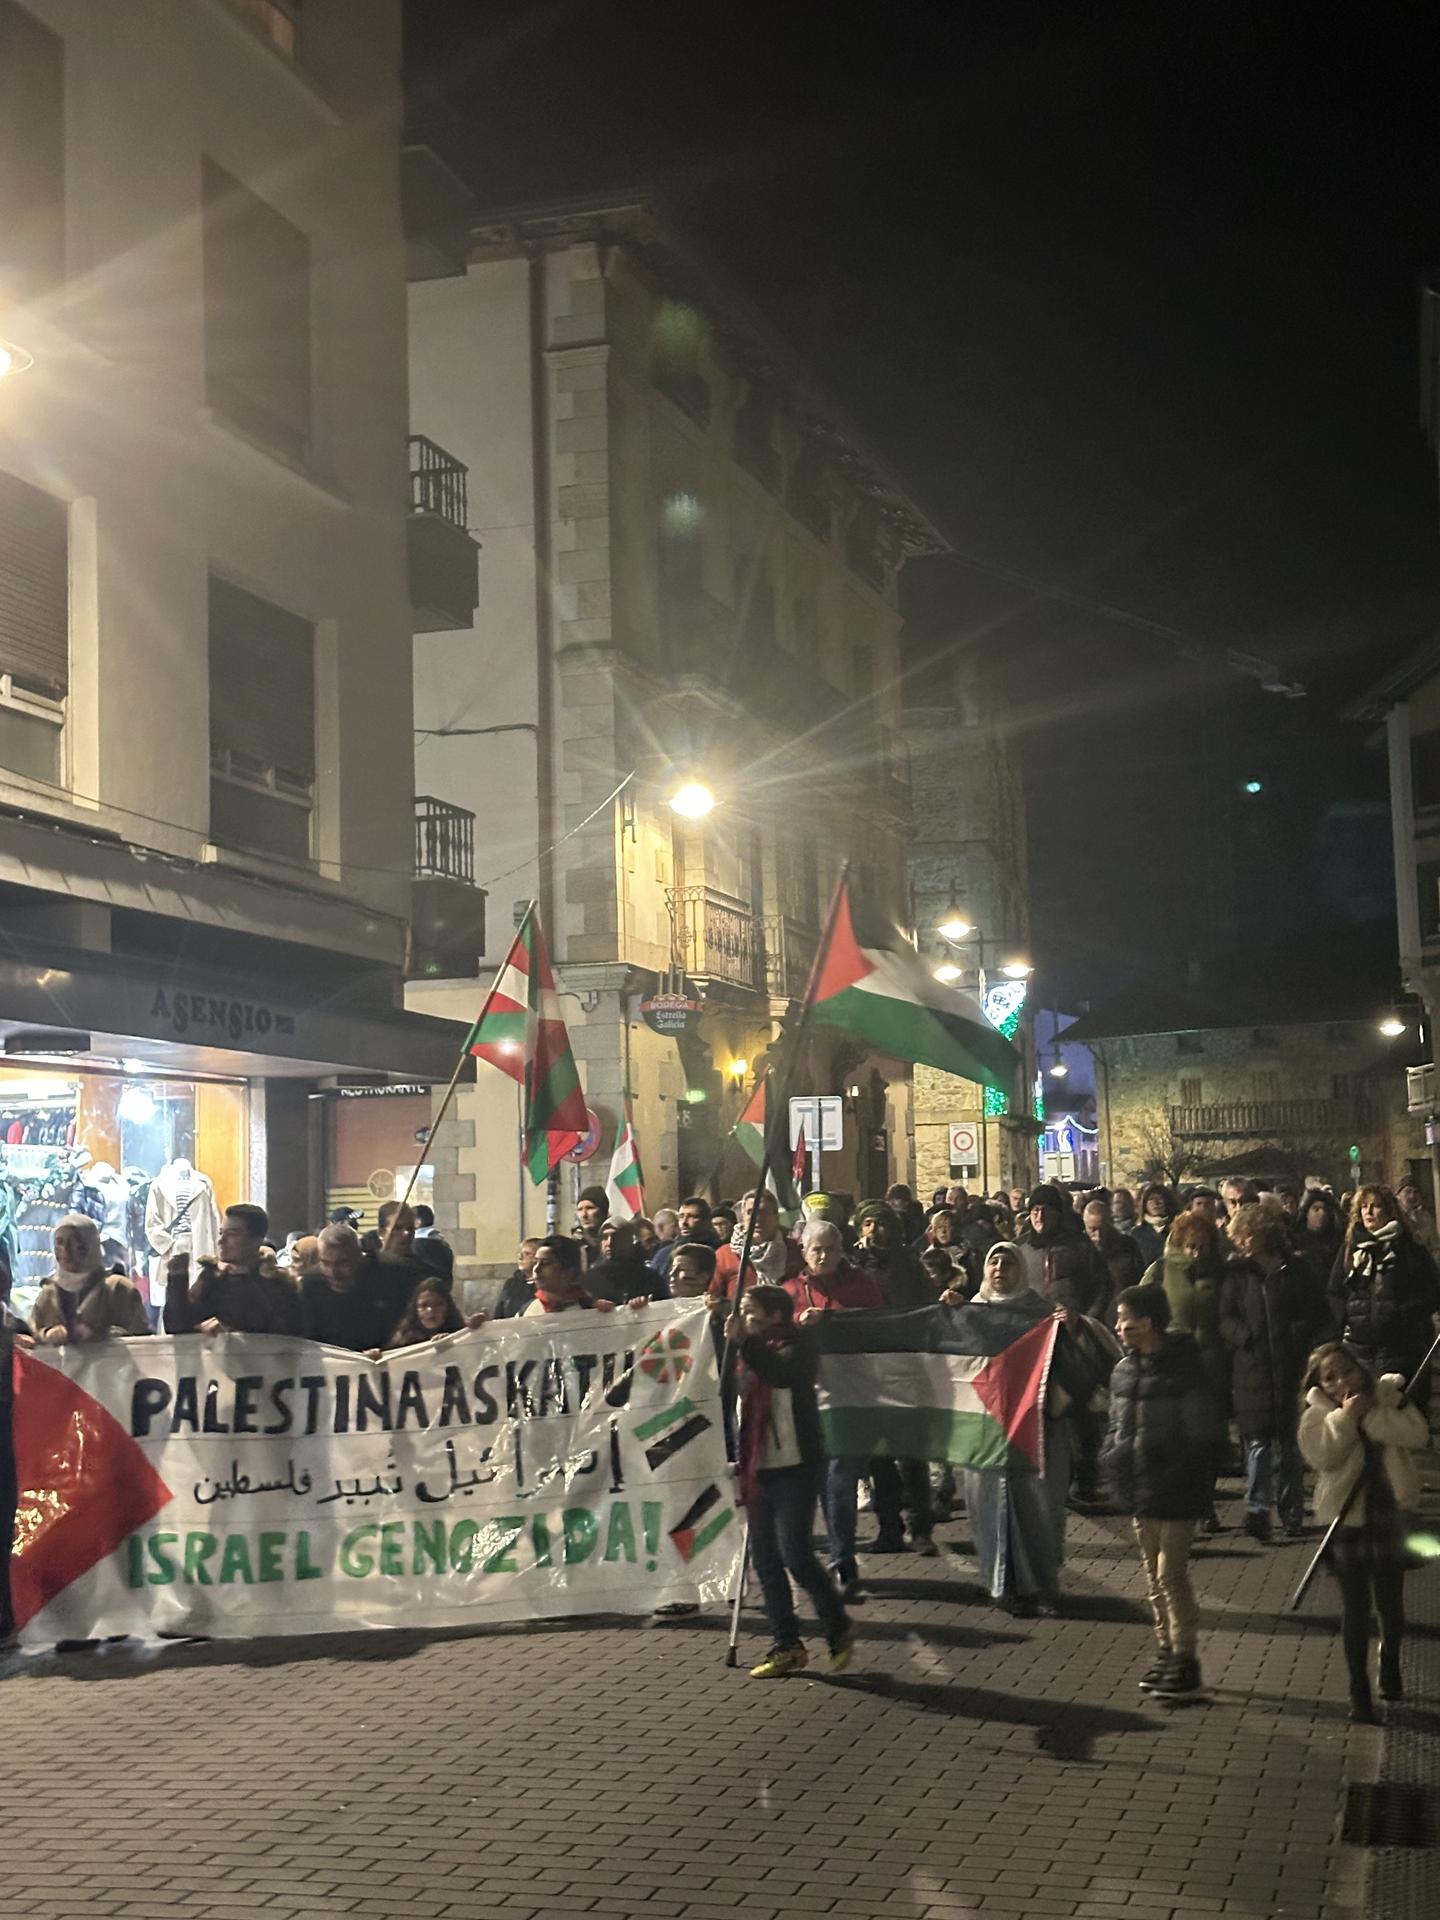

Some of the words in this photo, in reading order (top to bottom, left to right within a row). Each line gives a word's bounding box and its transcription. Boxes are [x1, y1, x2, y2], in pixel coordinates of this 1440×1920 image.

[151, 986, 273, 1040] ASENSIO
[656, 1010, 687, 1020] Estrella
[656, 1020, 685, 1029] Galicia
[131, 1370, 430, 1437] PALESTINA
[439, 1350, 634, 1427] ASKATU
[194, 1458, 312, 1504] فلسطين
[128, 1530, 323, 1589] ISRAEL
[339, 1500, 663, 1579] GENOZIDA!
